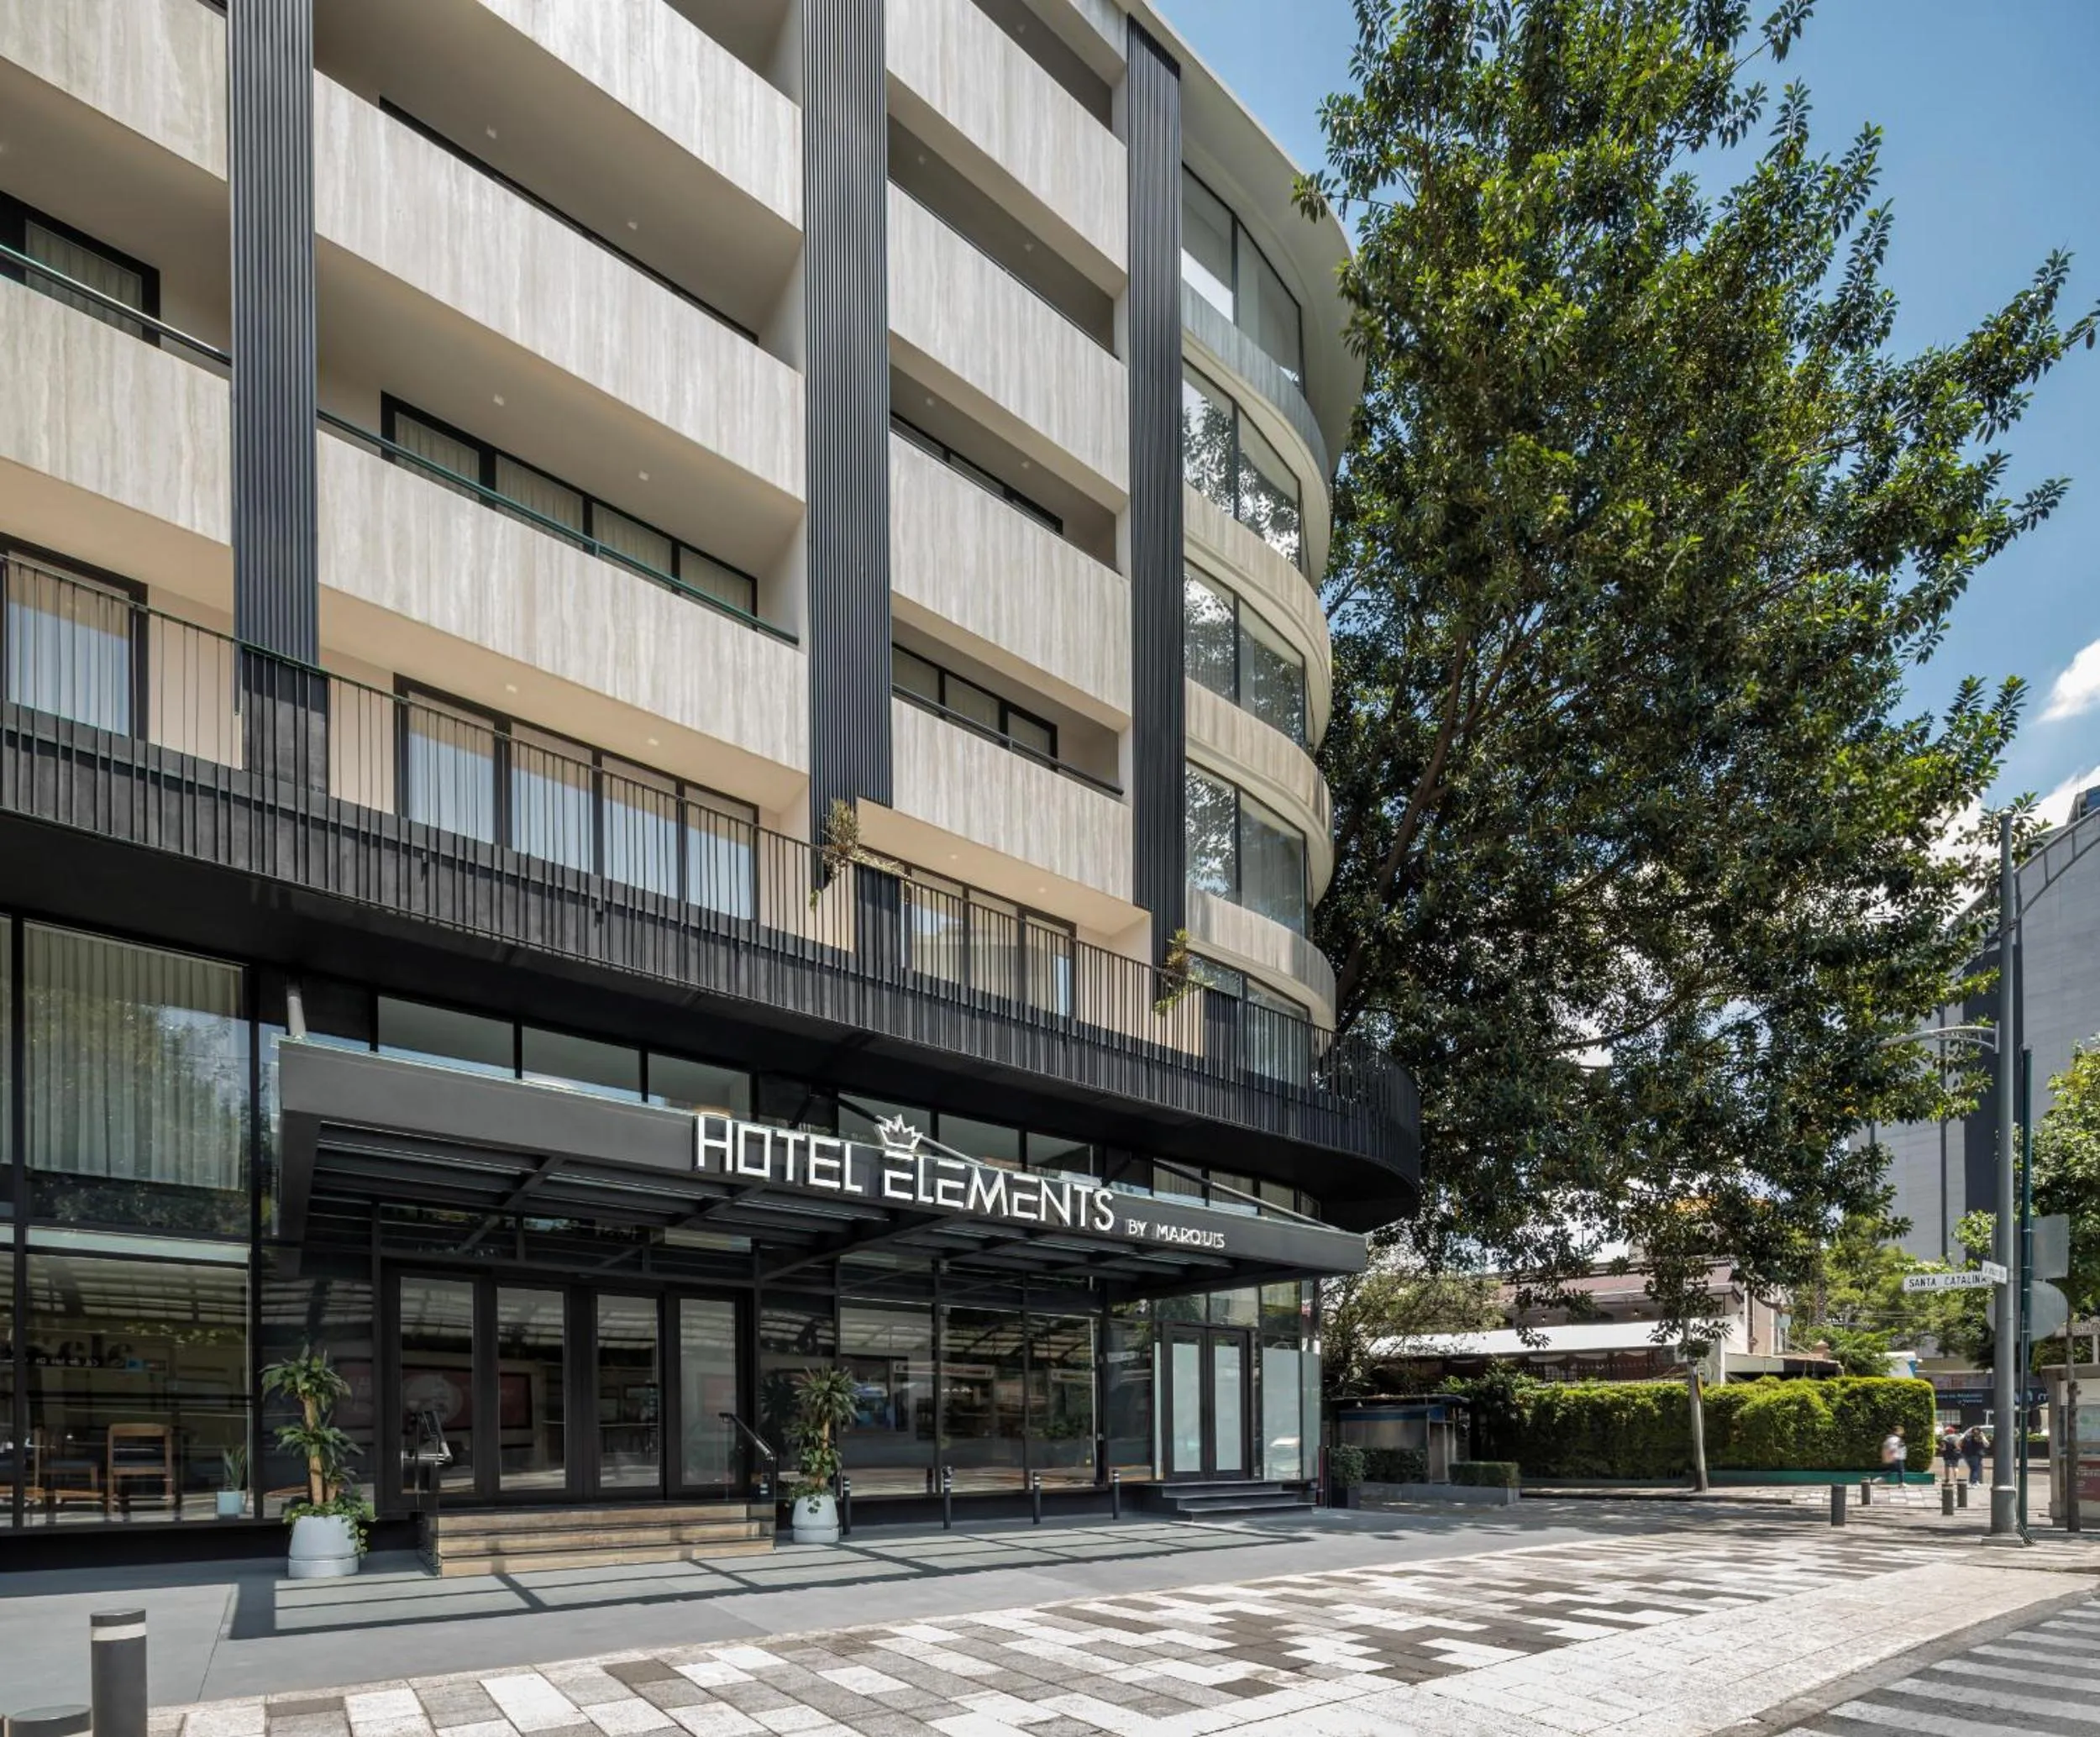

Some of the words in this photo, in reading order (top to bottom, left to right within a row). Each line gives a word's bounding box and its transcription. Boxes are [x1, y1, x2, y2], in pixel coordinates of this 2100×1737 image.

[696, 1114, 864, 1193] HOTEL
[883, 1150, 1115, 1231] ELEMENTS
[1126, 1218, 1146, 1237] BY
[1156, 1223, 1226, 1250] MARQUIS
[1908, 1278, 1937, 1288] SANTA
[1944, 1273, 1987, 1286] CATALINA
